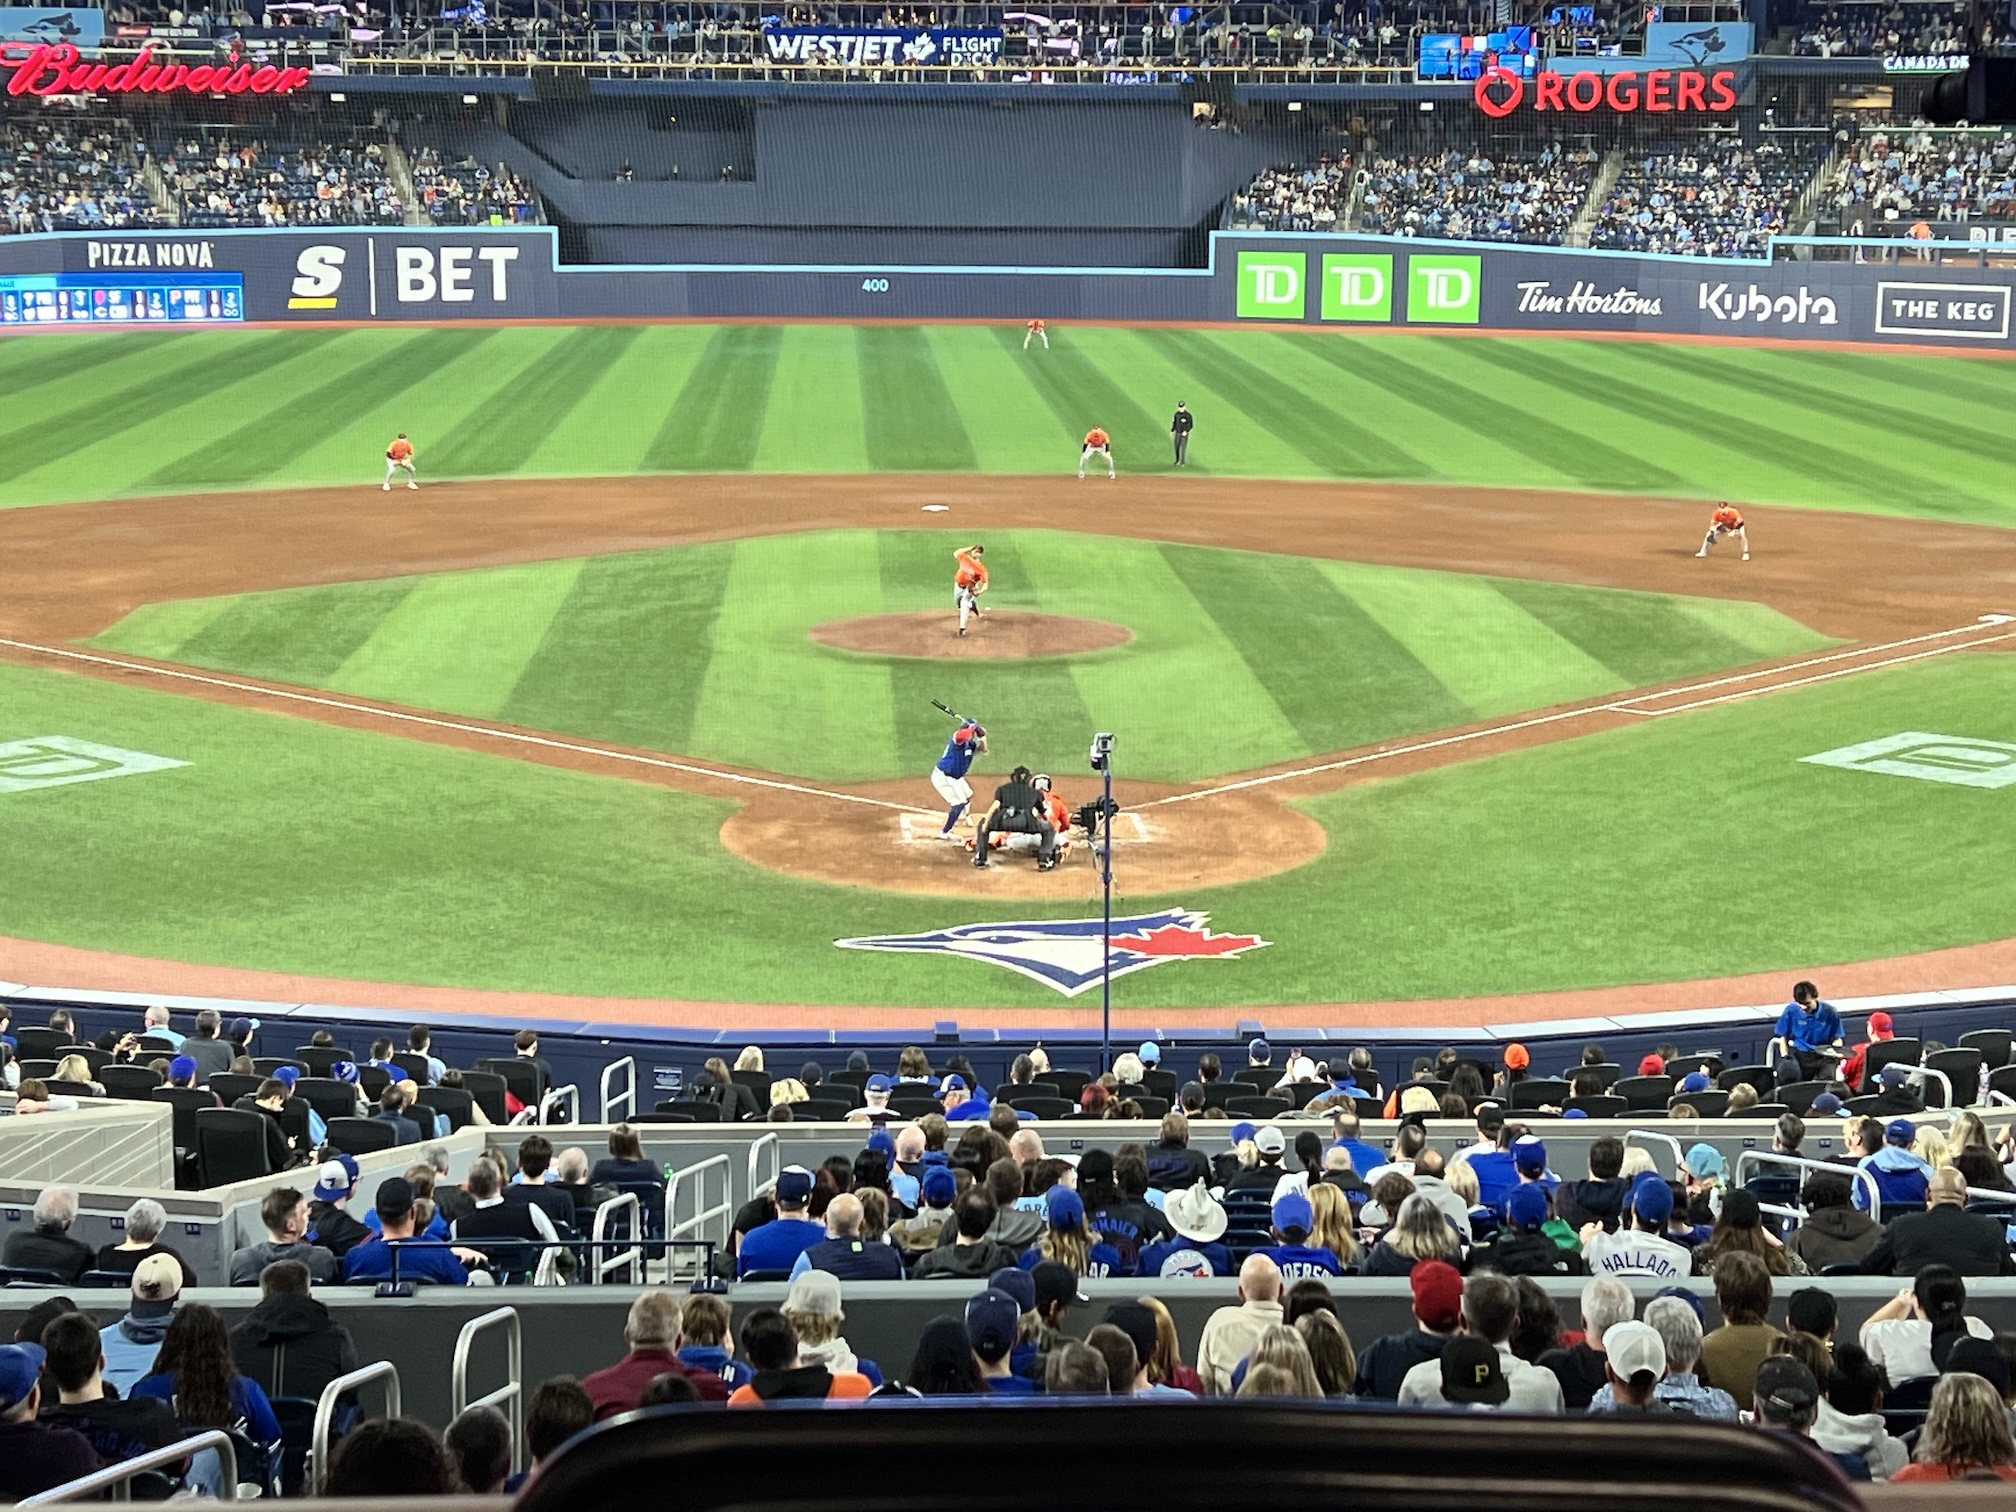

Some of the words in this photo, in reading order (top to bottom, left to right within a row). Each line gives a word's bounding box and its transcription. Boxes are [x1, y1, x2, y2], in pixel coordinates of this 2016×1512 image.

[766, 35, 902, 61] WESTJET
[942, 36, 1002, 52] FLIGHT
[0, 41, 310, 96] Budweiser
[1534, 71, 1736, 112] ROGERS
[88, 241, 151, 268] PIZZA
[156, 240, 214, 268] NOVA
[396, 246, 519, 302] BET
[862, 278, 889, 292] 400
[1245, 264, 1299, 304] TD
[1330, 266, 1384, 306] TD
[1416, 267, 1472, 308] TD
[1517, 281, 1563, 314] Tim
[1565, 280, 1662, 315] Hortons
[1698, 282, 1838, 325] Kubota
[1891, 299, 1939, 318] THE
[1947, 302, 1996, 321] KEG
[1601, 1251, 1681, 1278] HALLADA
[1475, 1365, 1490, 1383] P
